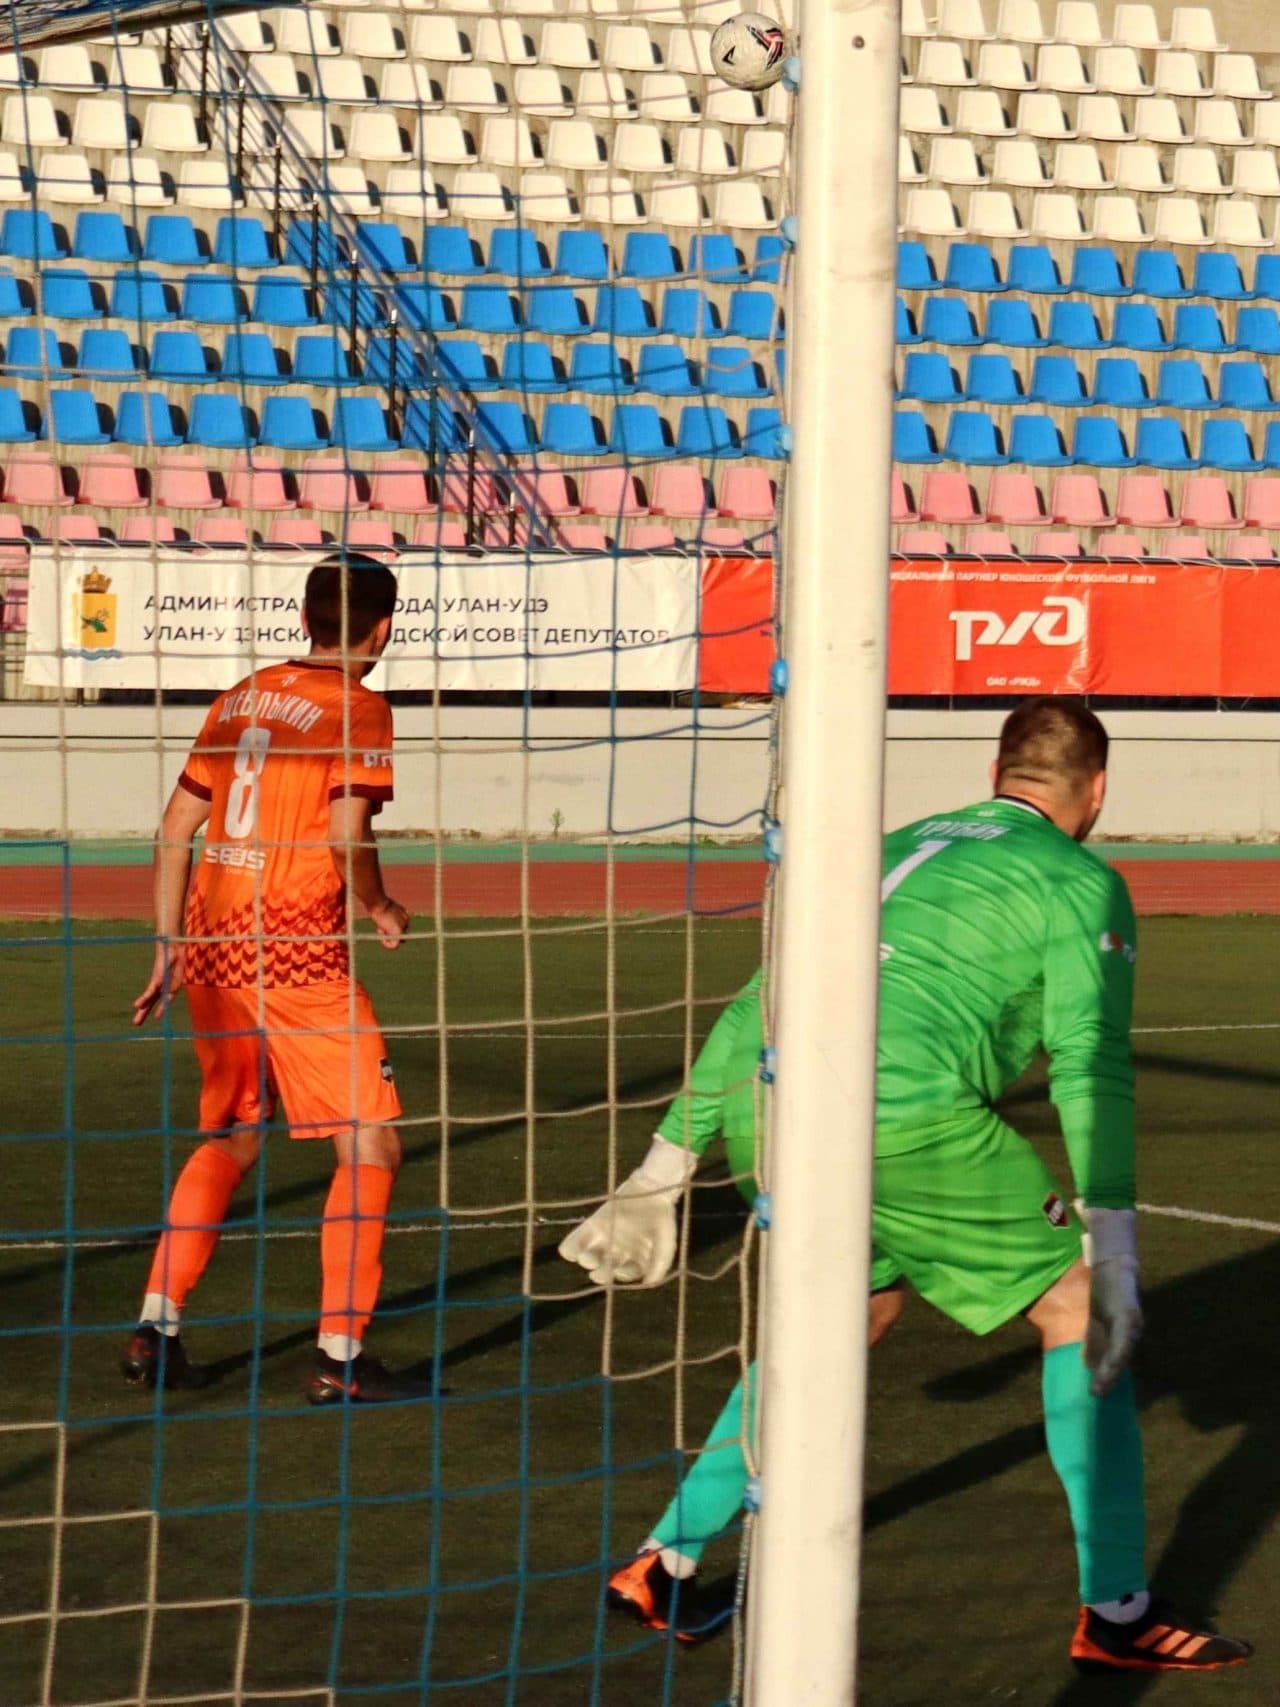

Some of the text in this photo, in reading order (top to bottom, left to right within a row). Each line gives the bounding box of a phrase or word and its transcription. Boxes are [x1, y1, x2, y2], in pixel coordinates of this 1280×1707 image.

[144, 595, 300, 612] АДМИНИСТРА
[443, 598, 549, 614] УЛАН-УДЭ
[143, 624, 671, 645] УЛАН-УДЭНСК ДСКОЙ СОВЕТ ДЕПУТАТОВ
[224, 727, 272, 839] 8
